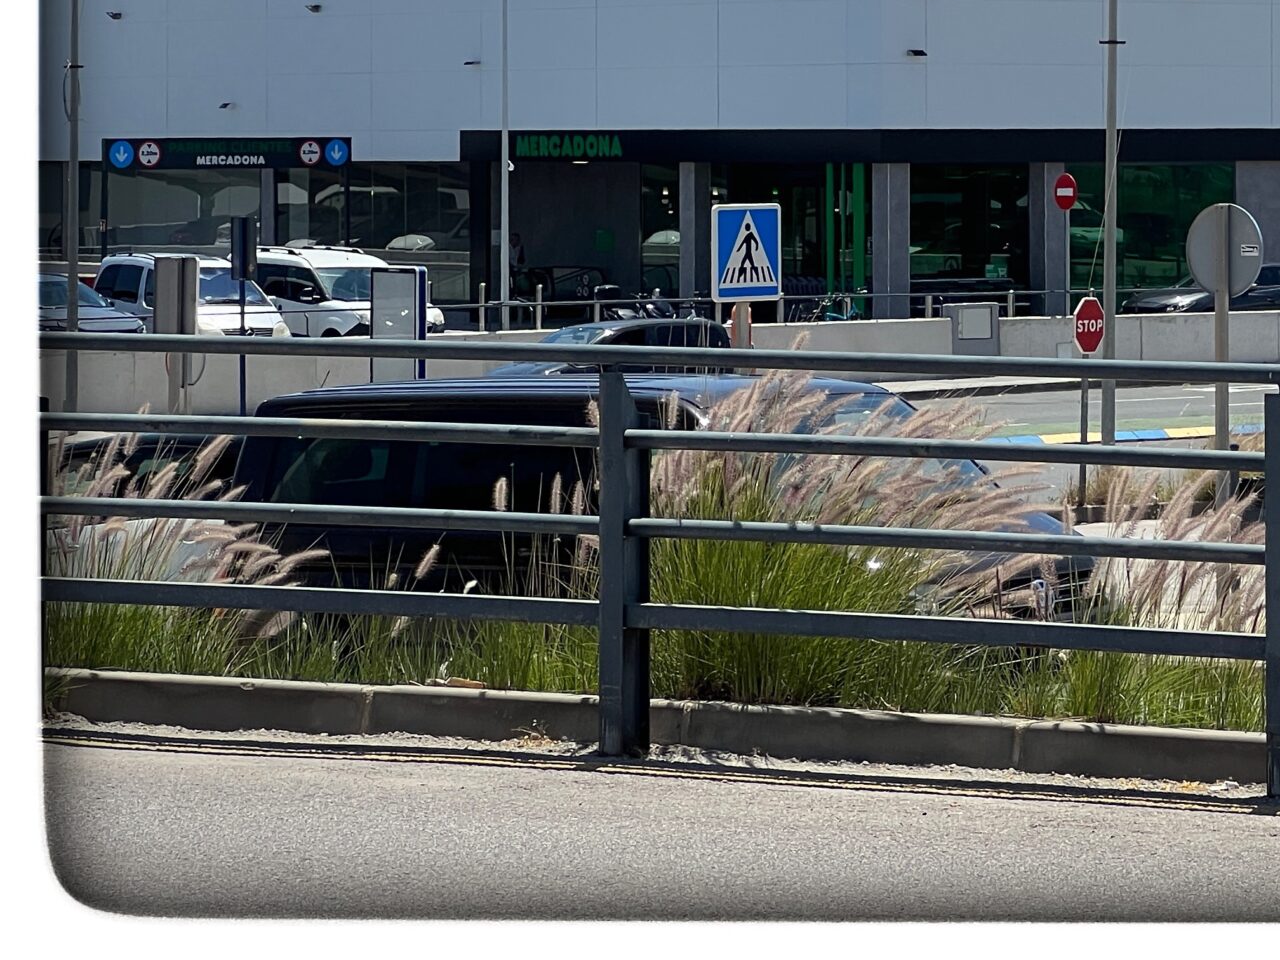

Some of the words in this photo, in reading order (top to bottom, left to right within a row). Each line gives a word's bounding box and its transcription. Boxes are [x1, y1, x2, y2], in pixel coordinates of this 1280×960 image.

[516, 134, 622, 157] MERCADONA
[196, 155, 266, 166] MERCADONA
[1077, 320, 1103, 333] STOP
